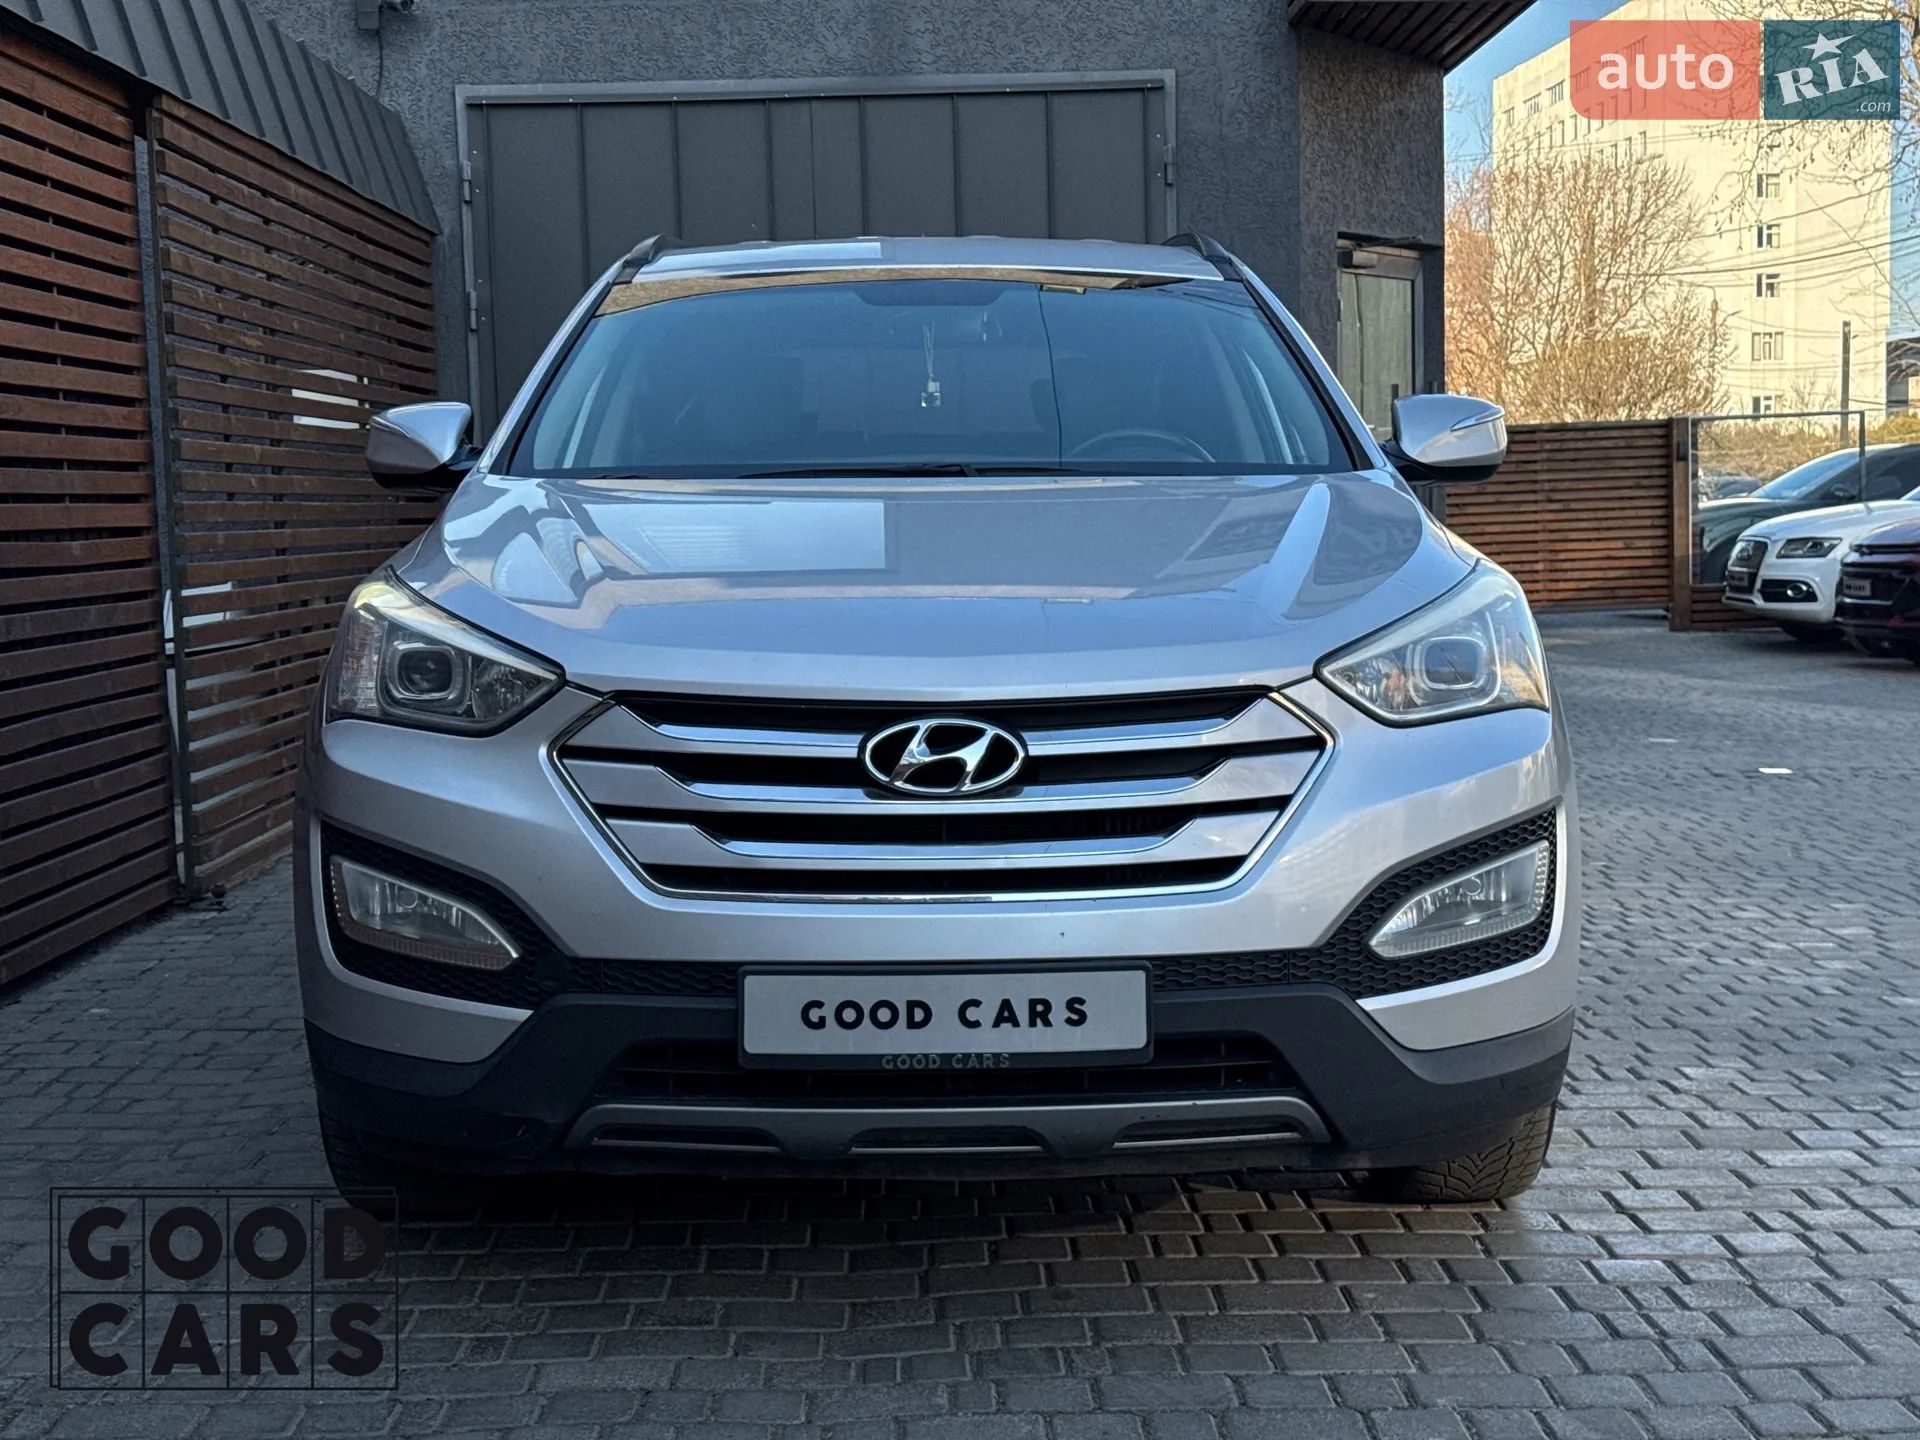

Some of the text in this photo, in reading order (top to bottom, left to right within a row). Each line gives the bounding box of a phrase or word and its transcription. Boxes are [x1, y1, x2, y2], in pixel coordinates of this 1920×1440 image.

[800, 996, 1089, 1030] GOOD CARS
[881, 1053, 1011, 1069] GOOD CARS
